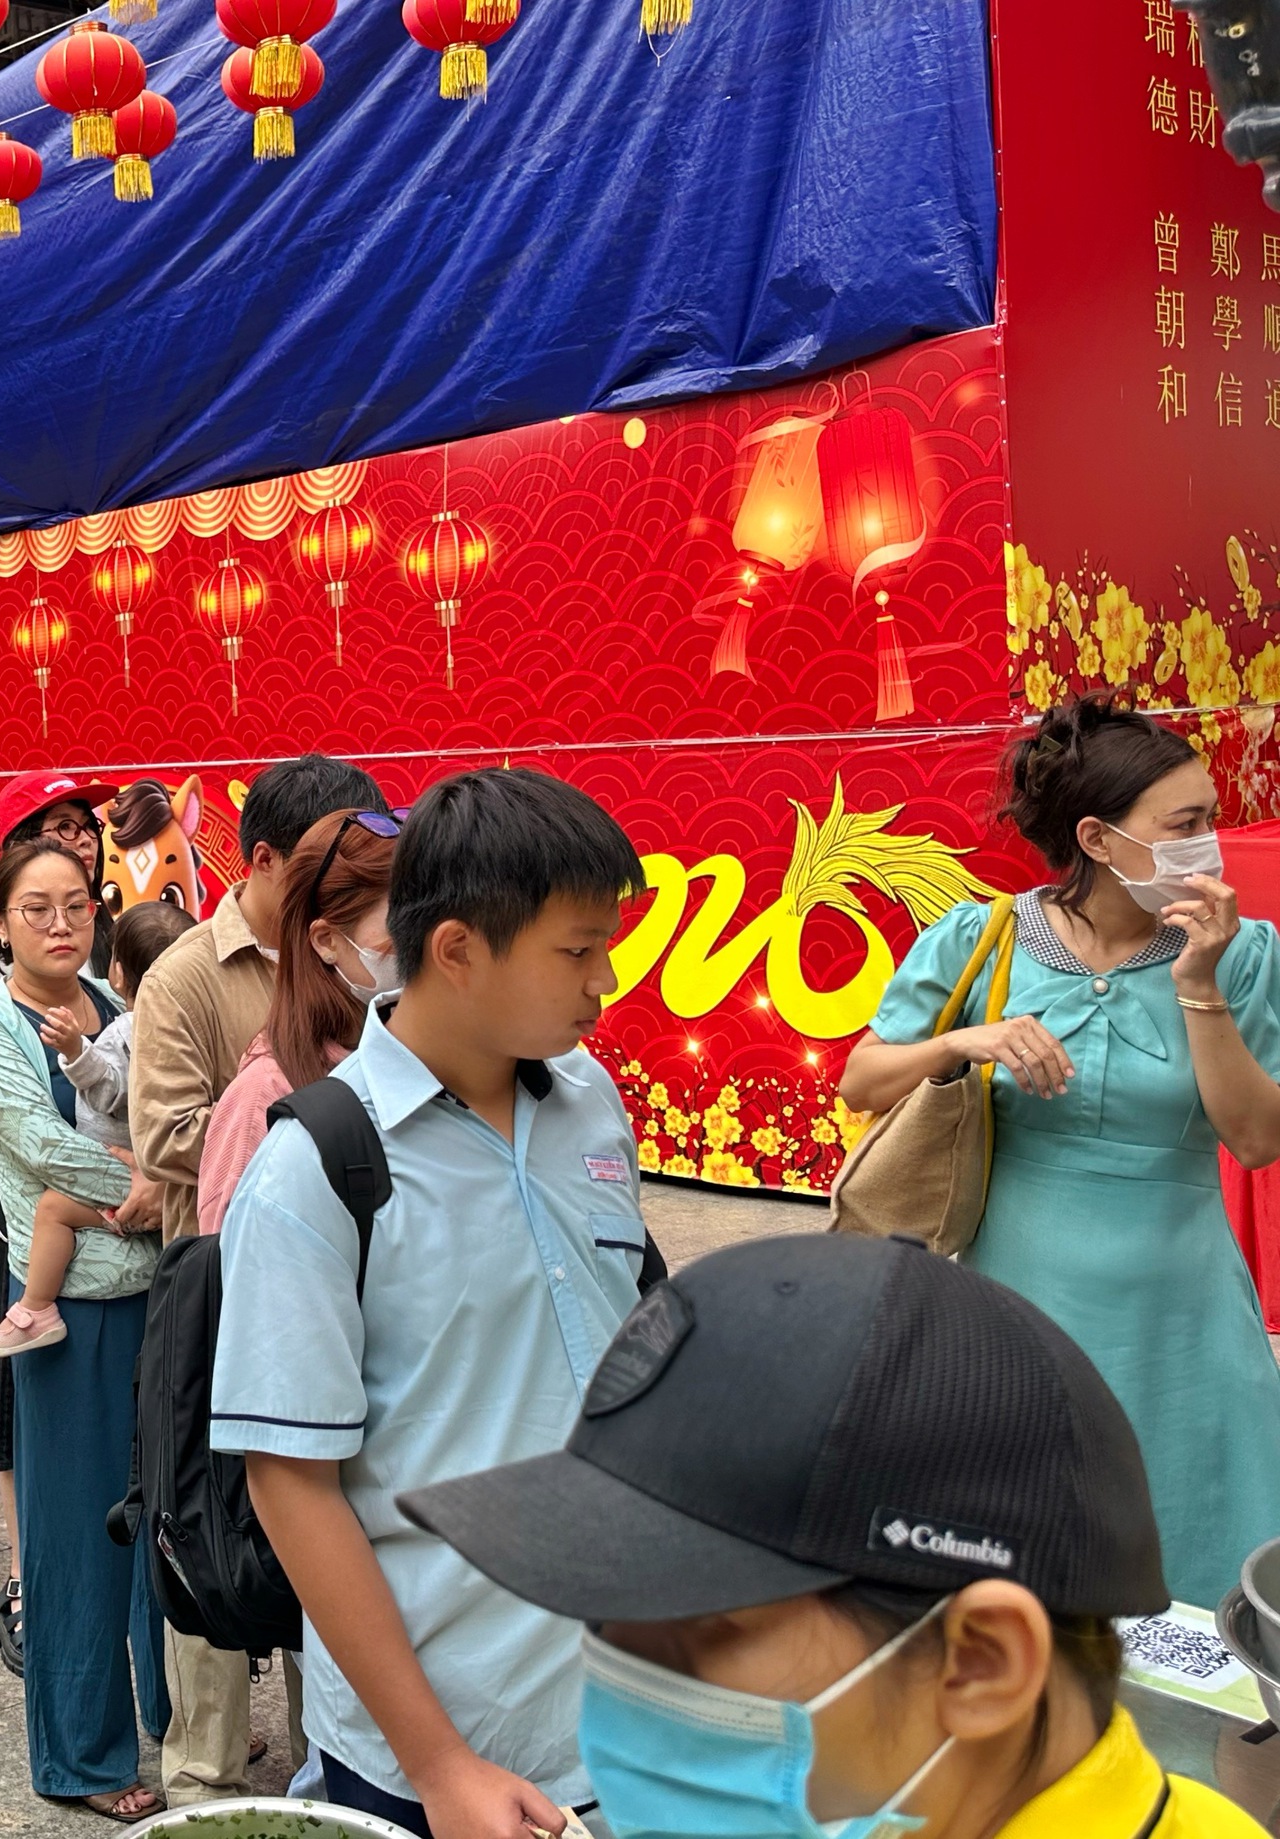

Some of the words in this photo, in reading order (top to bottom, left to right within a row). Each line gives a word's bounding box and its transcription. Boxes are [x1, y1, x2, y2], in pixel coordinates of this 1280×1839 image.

[1153, 211, 1188, 425] 曾朝和
[1210, 222, 1243, 429] 鄭學信
[909, 1524, 1014, 1567] Columbia
